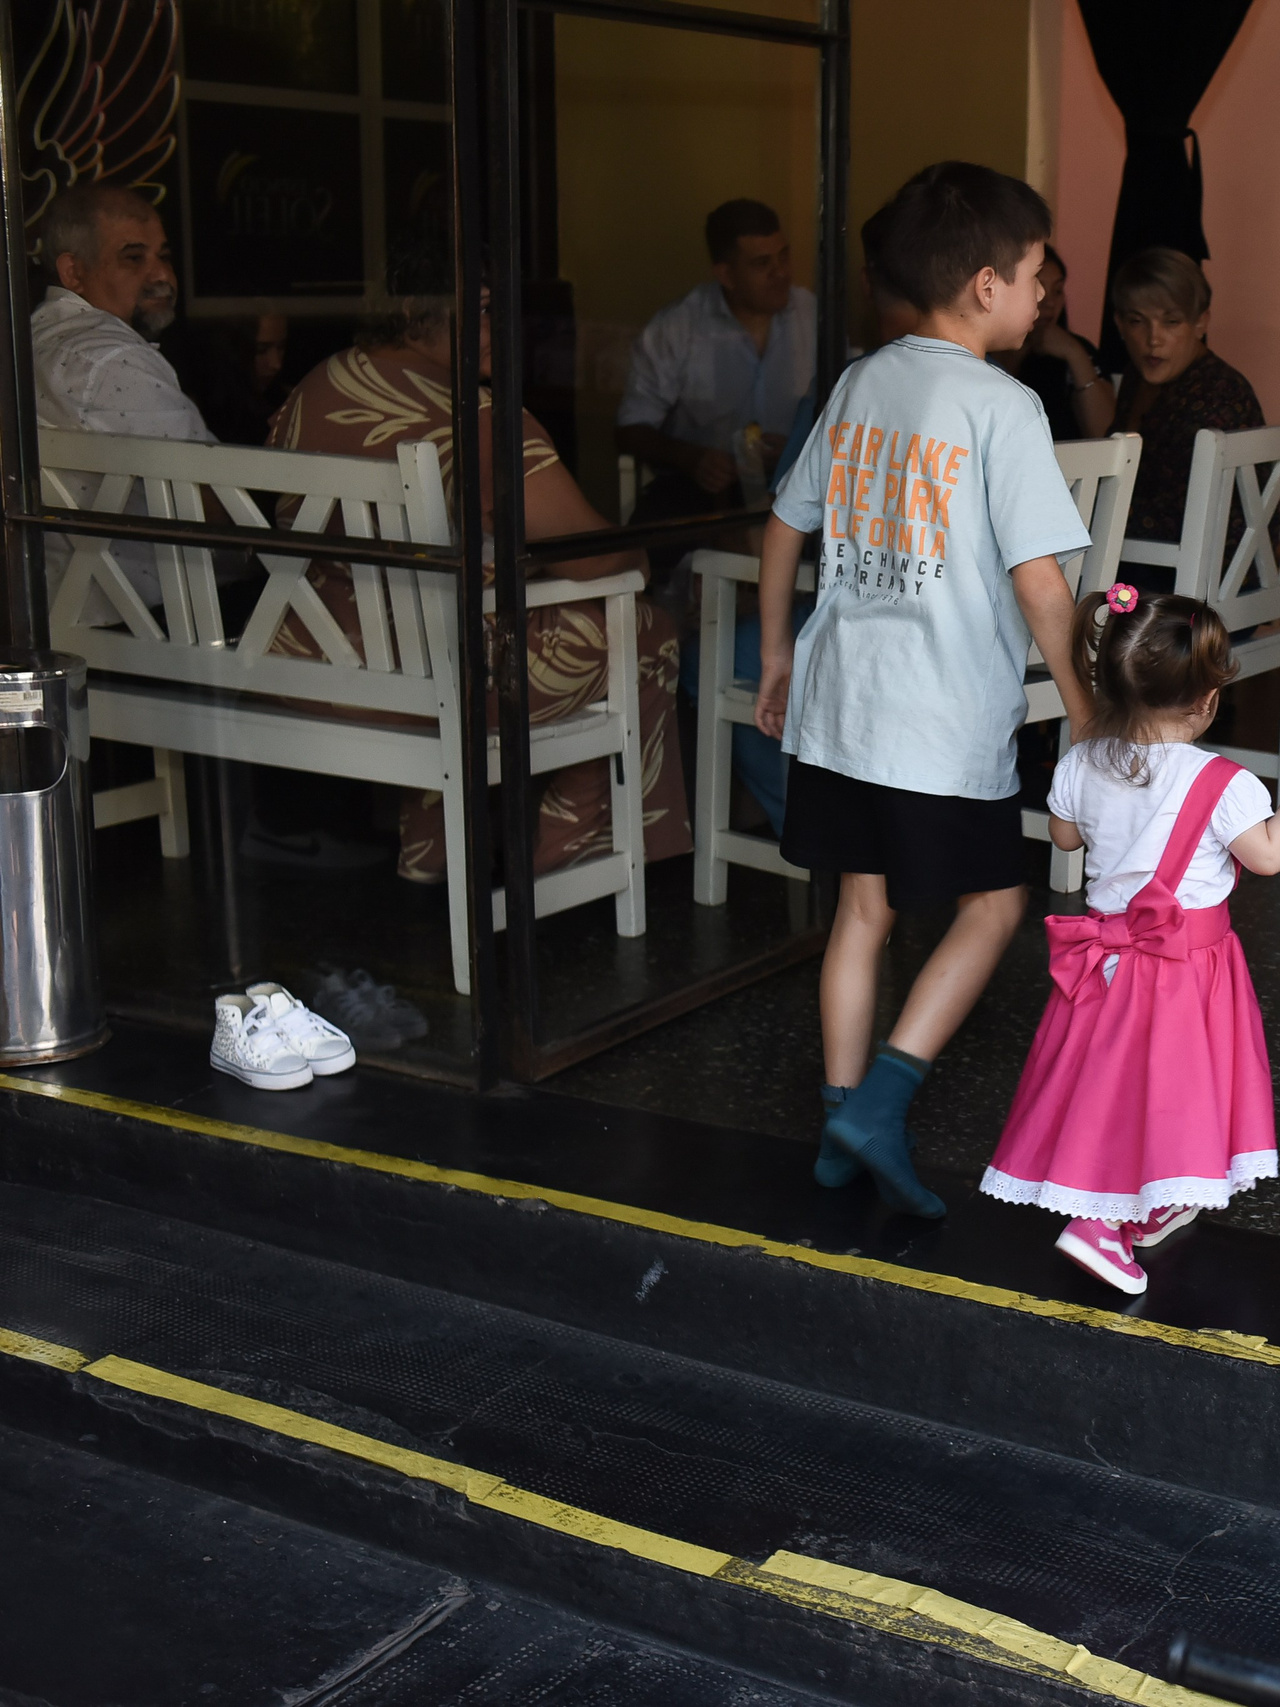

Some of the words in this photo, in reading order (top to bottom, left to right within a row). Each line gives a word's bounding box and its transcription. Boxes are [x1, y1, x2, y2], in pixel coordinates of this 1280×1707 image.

[829, 422, 883, 466] EAR
[889, 432, 969, 484] LAKE
[883, 472, 953, 528] PARK
[860, 570, 924, 596] READY
[863, 551, 944, 579] CHANCE
